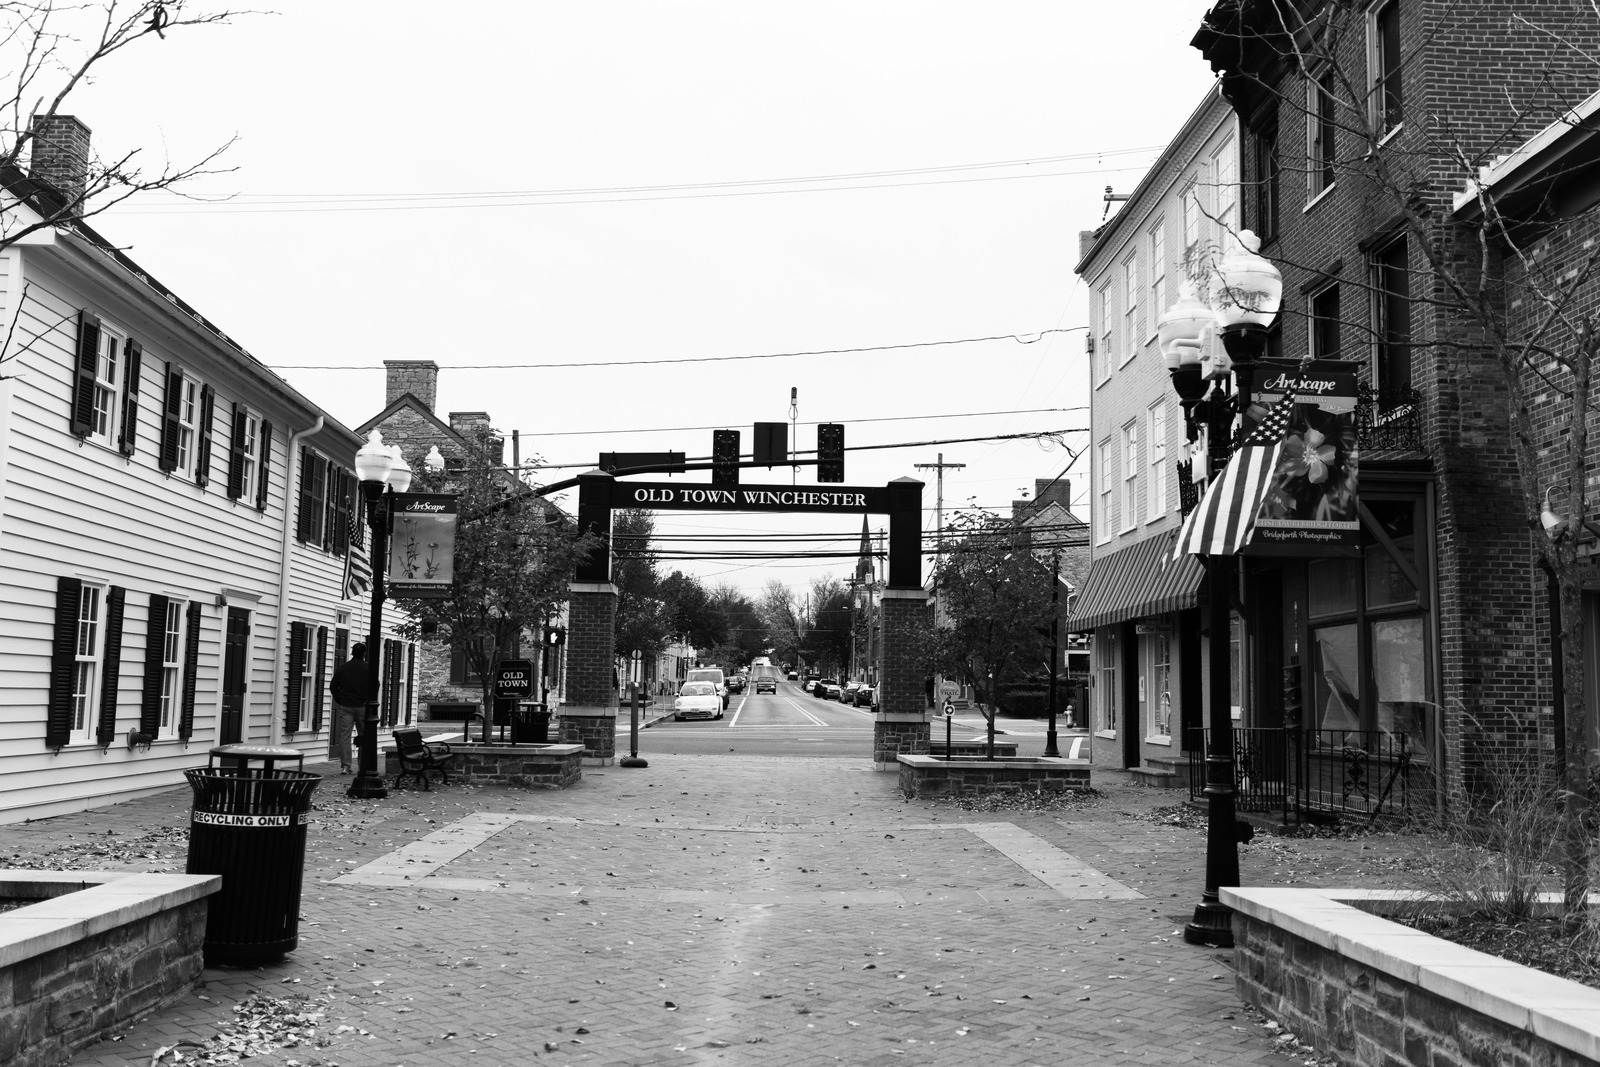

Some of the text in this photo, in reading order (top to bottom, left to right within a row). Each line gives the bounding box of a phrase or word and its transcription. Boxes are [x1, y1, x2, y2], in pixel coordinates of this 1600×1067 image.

[634, 488, 867, 507] OLD TOWN WINCHESTER
[406, 501, 445, 512] ArtScape
[1262, 530, 1342, 541] Bridgeforth Photographics
[195, 812, 289, 826] RECYCLING ONLY
